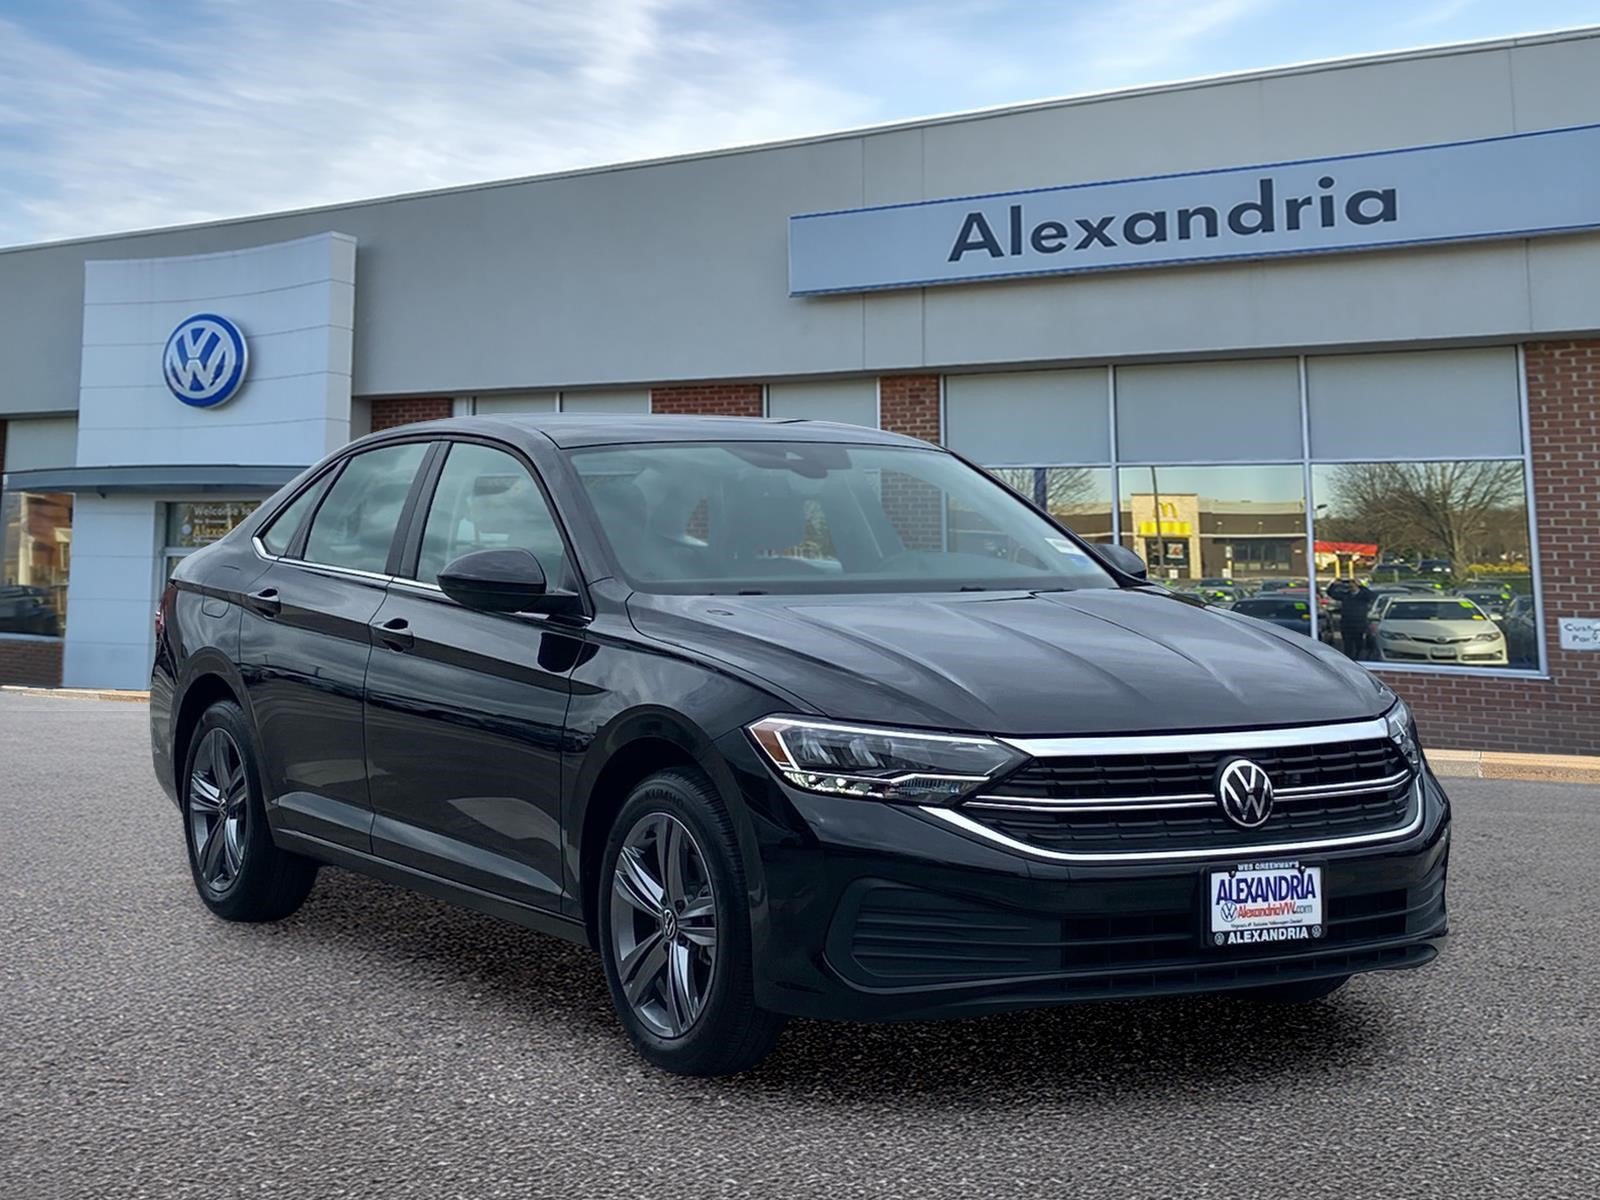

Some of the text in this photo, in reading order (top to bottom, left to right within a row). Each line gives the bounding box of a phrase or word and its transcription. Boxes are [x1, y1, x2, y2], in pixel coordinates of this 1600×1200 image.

[947, 176, 1397, 262] Alexandria
[1215, 873, 1317, 905] ALEXANDRIA
[1227, 926, 1309, 944] ALEXANDRIA
